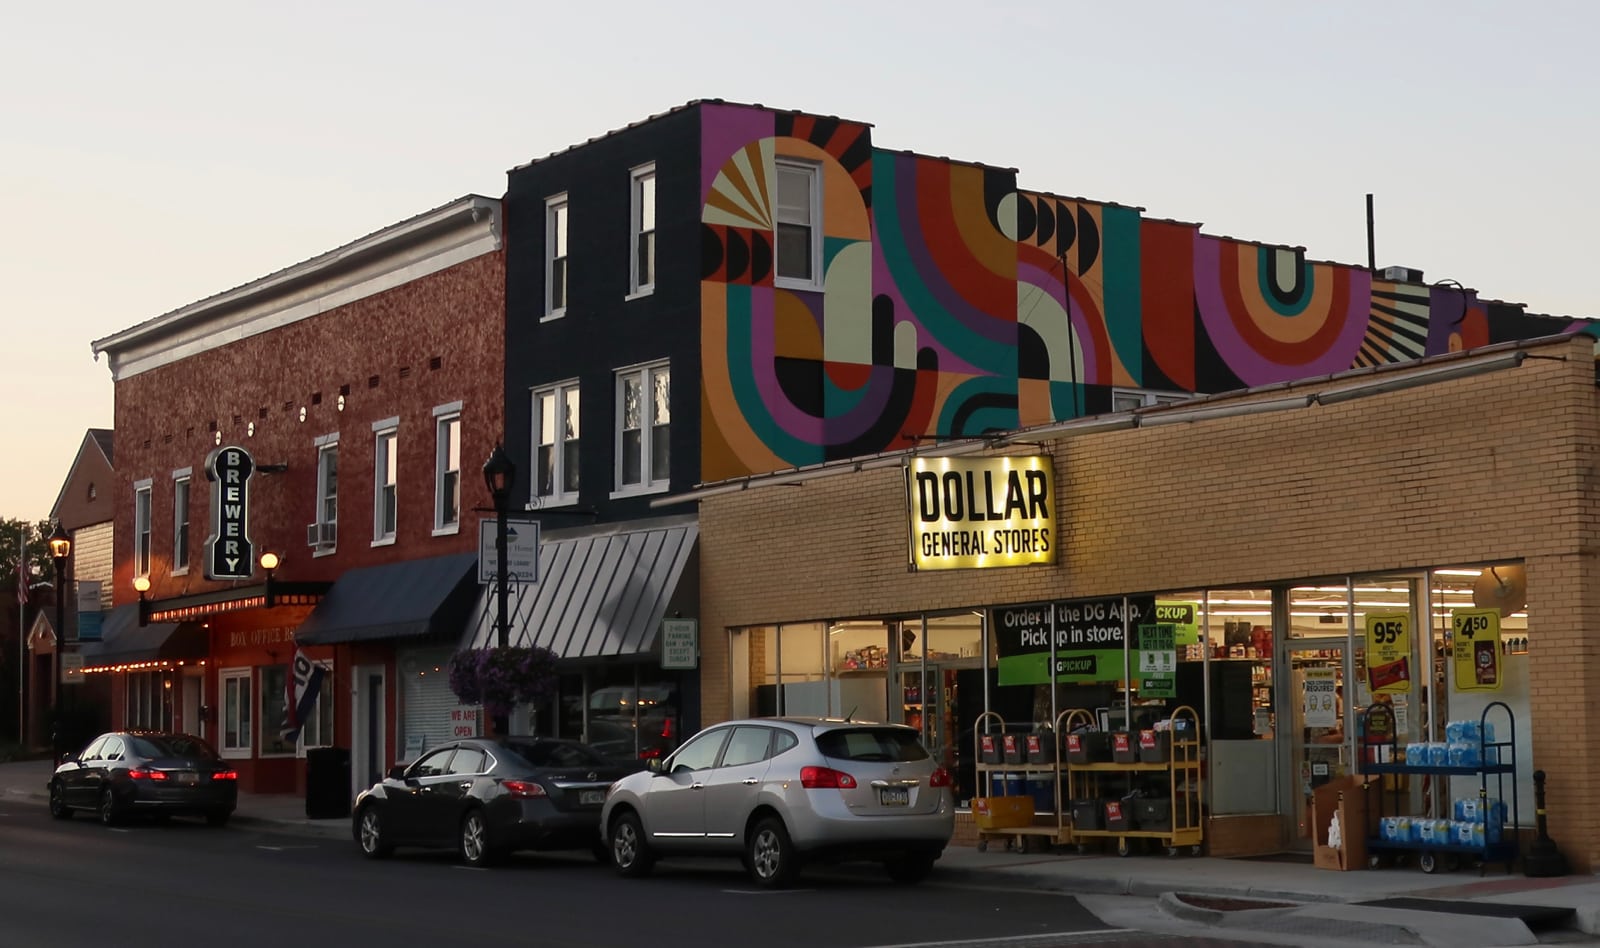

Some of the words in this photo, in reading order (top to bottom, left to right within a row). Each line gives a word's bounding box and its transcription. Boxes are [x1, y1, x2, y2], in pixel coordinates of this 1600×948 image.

[916, 470, 1049, 523] DOLLAR
[225, 451, 241, 572] BREWERY
[922, 530, 988, 556] GENERAL
[994, 528, 1049, 554] STORES
[1004, 609, 1041, 628] Order
[1058, 606, 1080, 622] the
[1084, 604, 1105, 621] DG
[1156, 607, 1187, 619] CKUP
[230, 631, 247, 648] BOX
[250, 627, 281, 645] OFFICE
[1021, 627, 1048, 647] Pick
[1071, 625, 1083, 643] in
[1086, 625, 1123, 642] store.
[1374, 621, 1403, 643] 95¢
[1056, 659, 1092, 672] GPICKUP
[451, 710, 461, 720] WE
[463, 710, 475, 720] ARE
[454, 726, 473, 736] OPEN
